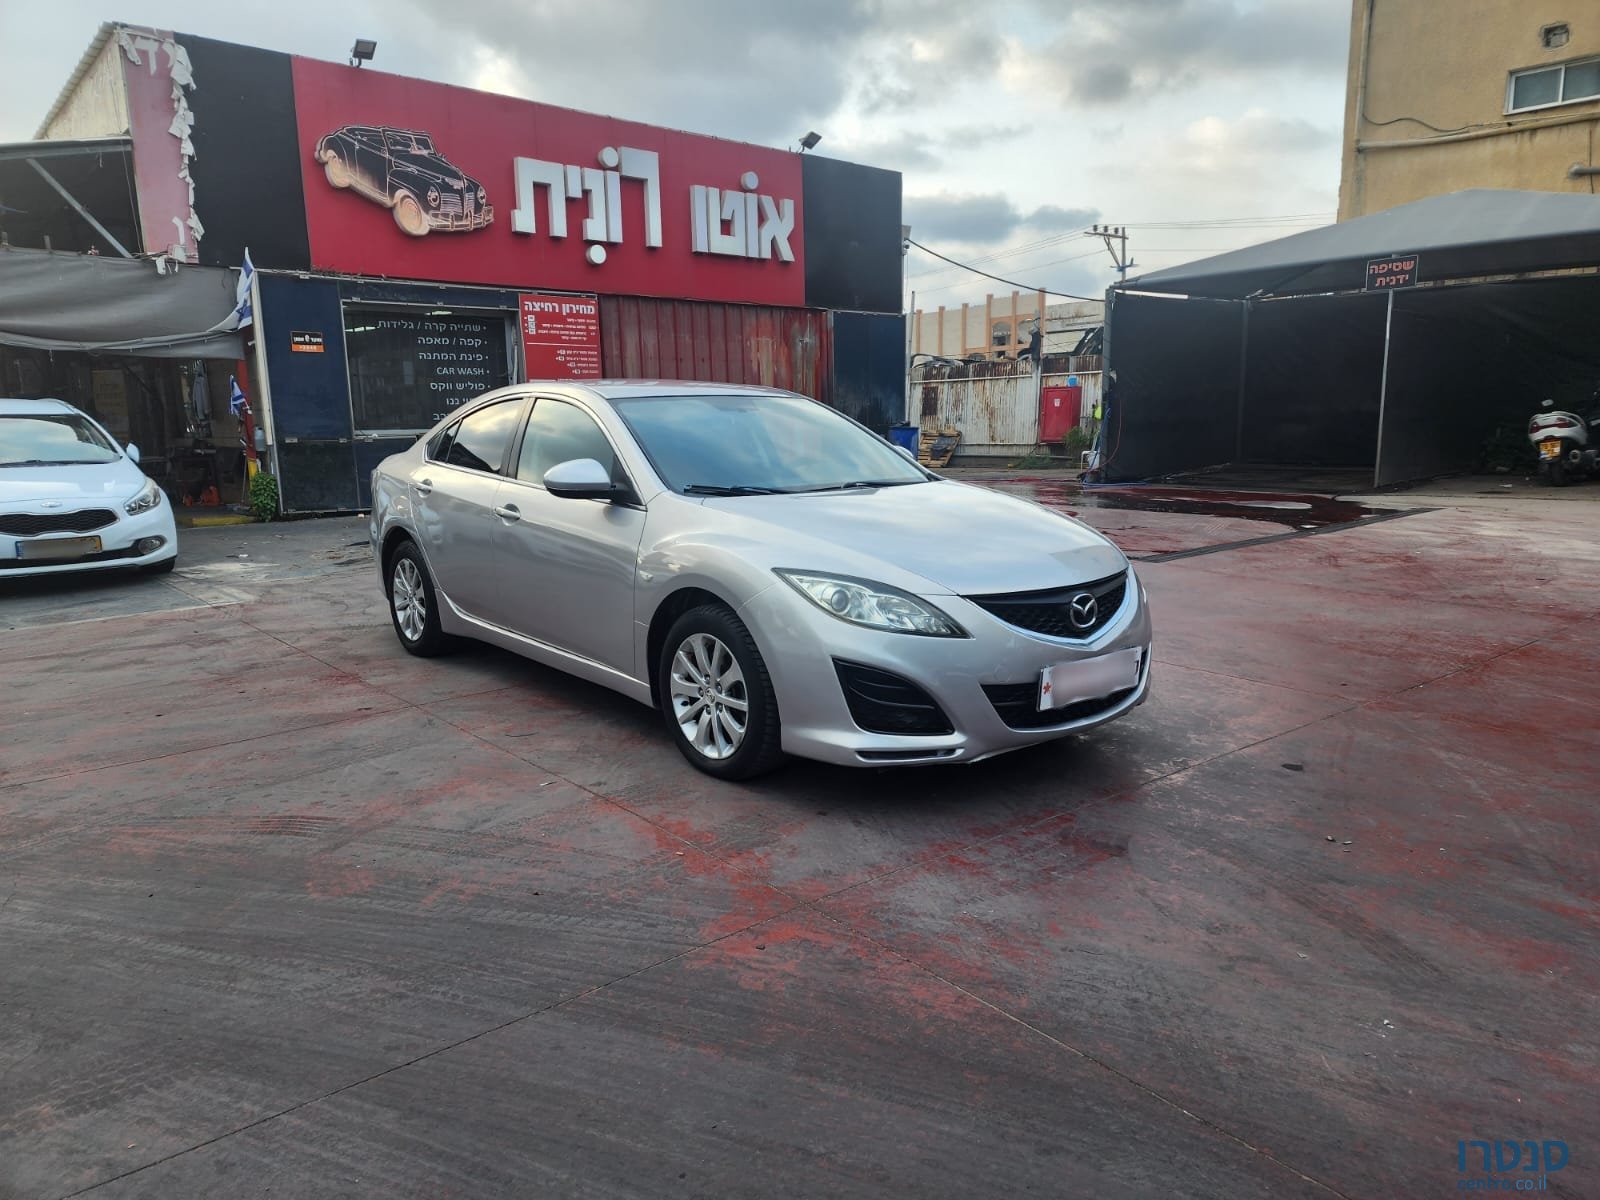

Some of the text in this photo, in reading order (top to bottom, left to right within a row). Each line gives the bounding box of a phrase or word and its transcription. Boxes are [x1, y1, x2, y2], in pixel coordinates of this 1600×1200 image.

[1375, 274, 1409, 287] ידנית
[524, 301, 596, 315] מחירון רחיצה
[377, 320, 414, 329] גלידות
[424, 322, 447, 333] קרה
[449, 323, 481, 332] שתייה
[417, 336, 450, 345] מאפה
[459, 338, 482, 348] קפה
[418, 352, 483, 361] פינת המתנה
[436, 367, 485, 376] CAR WASH
[430, 381, 485, 392] פוליש ווקס
